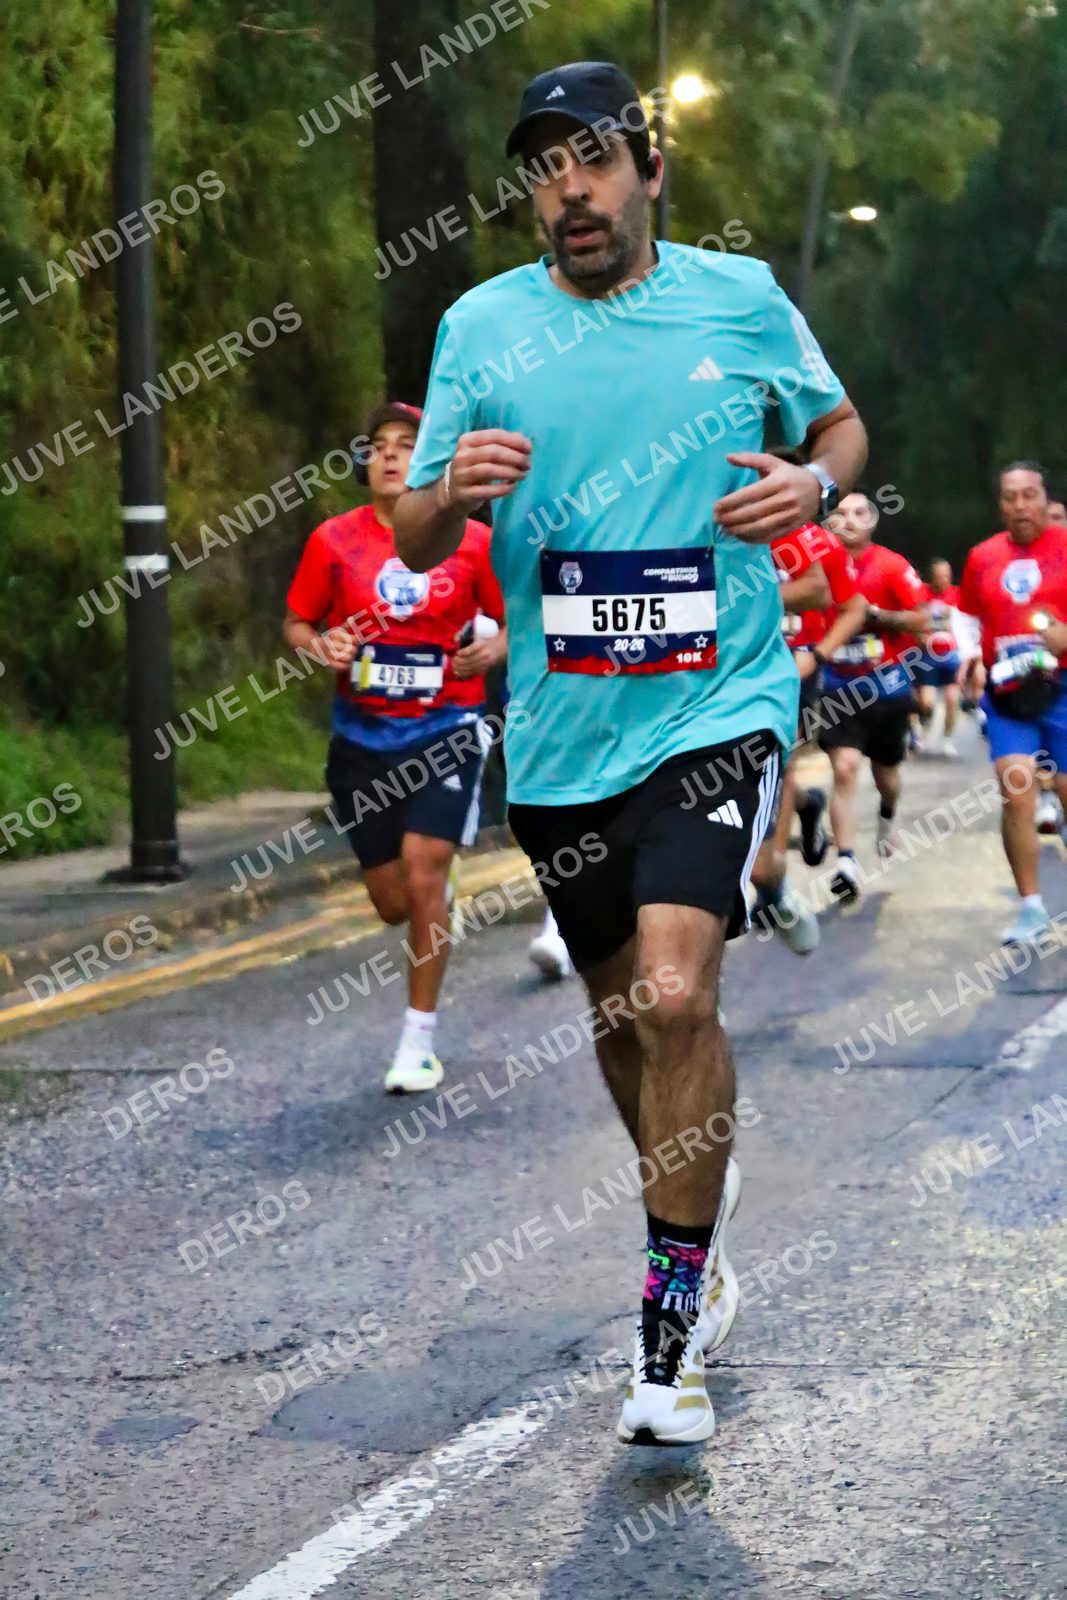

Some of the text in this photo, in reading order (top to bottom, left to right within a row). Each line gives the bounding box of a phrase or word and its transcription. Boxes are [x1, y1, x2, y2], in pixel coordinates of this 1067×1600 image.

[592, 597, 666, 632] 5675
[676, 651, 702, 663] 10K
[379, 666, 416, 685] 4763
